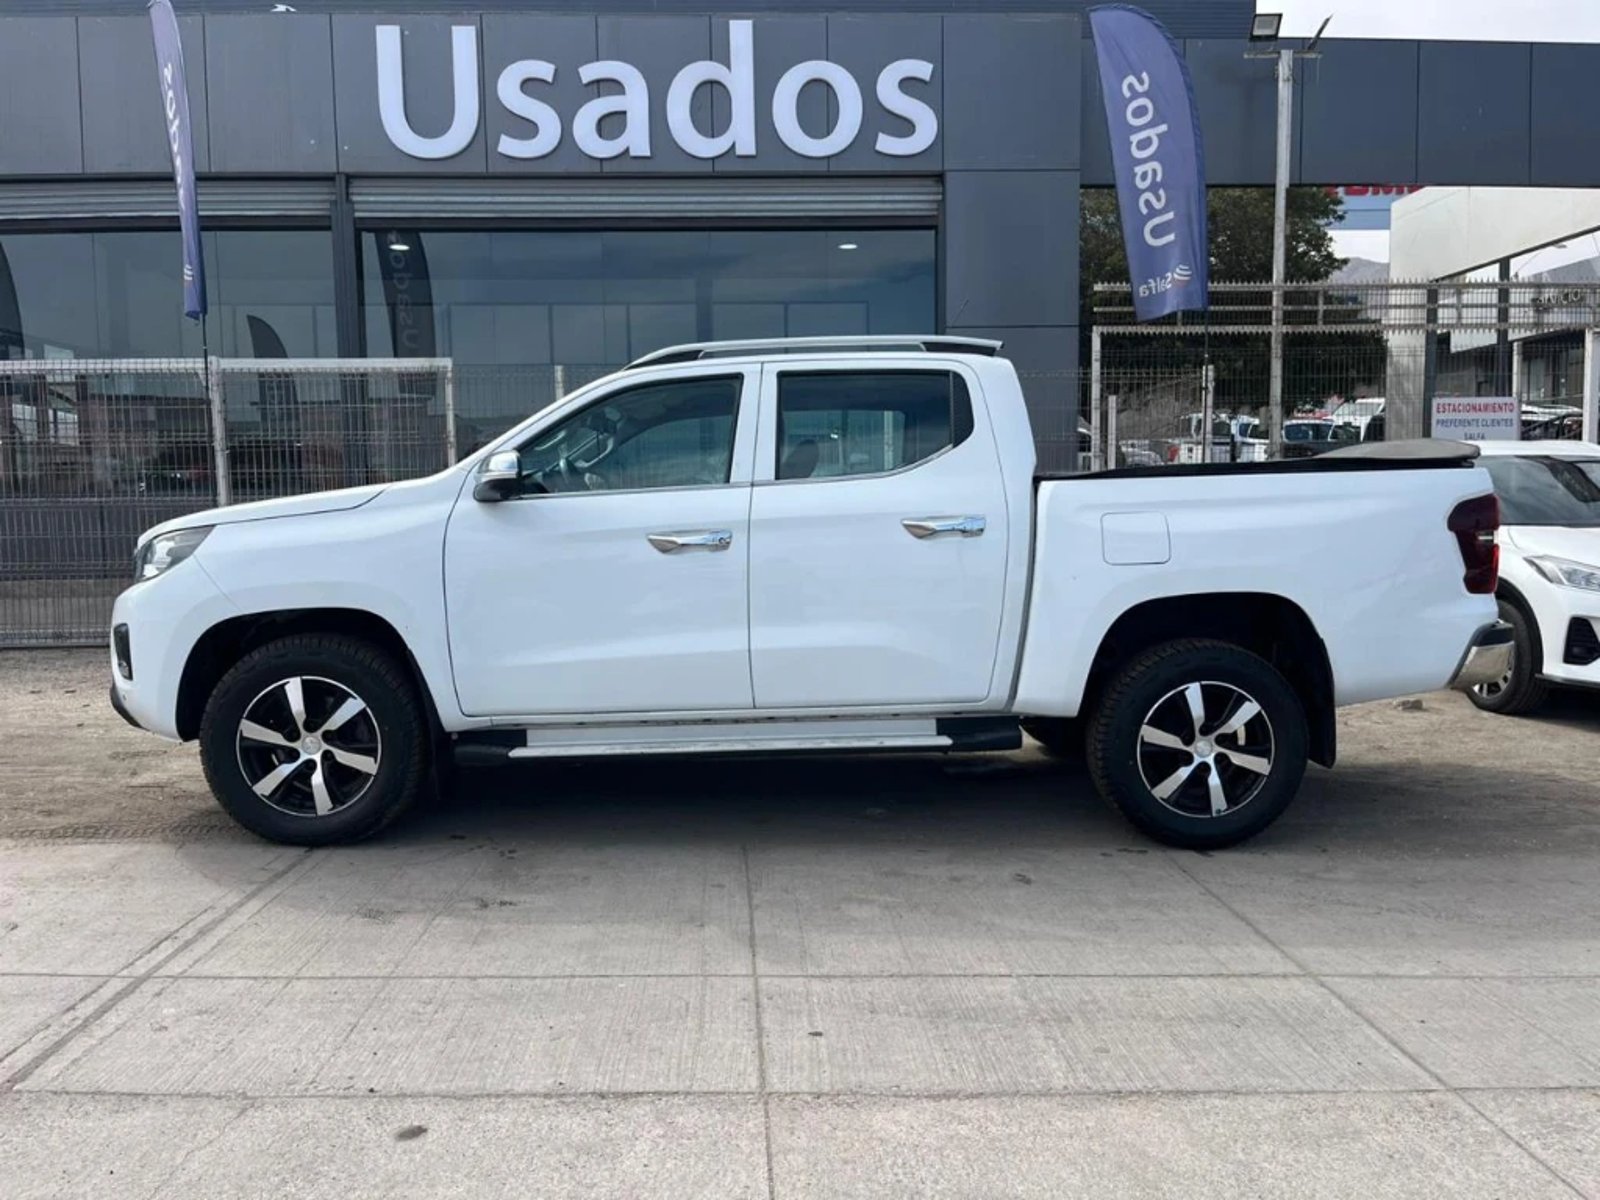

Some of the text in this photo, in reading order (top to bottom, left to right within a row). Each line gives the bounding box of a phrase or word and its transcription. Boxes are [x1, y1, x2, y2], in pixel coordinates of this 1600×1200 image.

[375, 19, 939, 160] Usados
[1436, 402, 1515, 414] ESTACIONAMIENTO
[1436, 418, 1514, 428] PREFERENTE CLIENTES
[1464, 432, 1486, 441] SALFA
